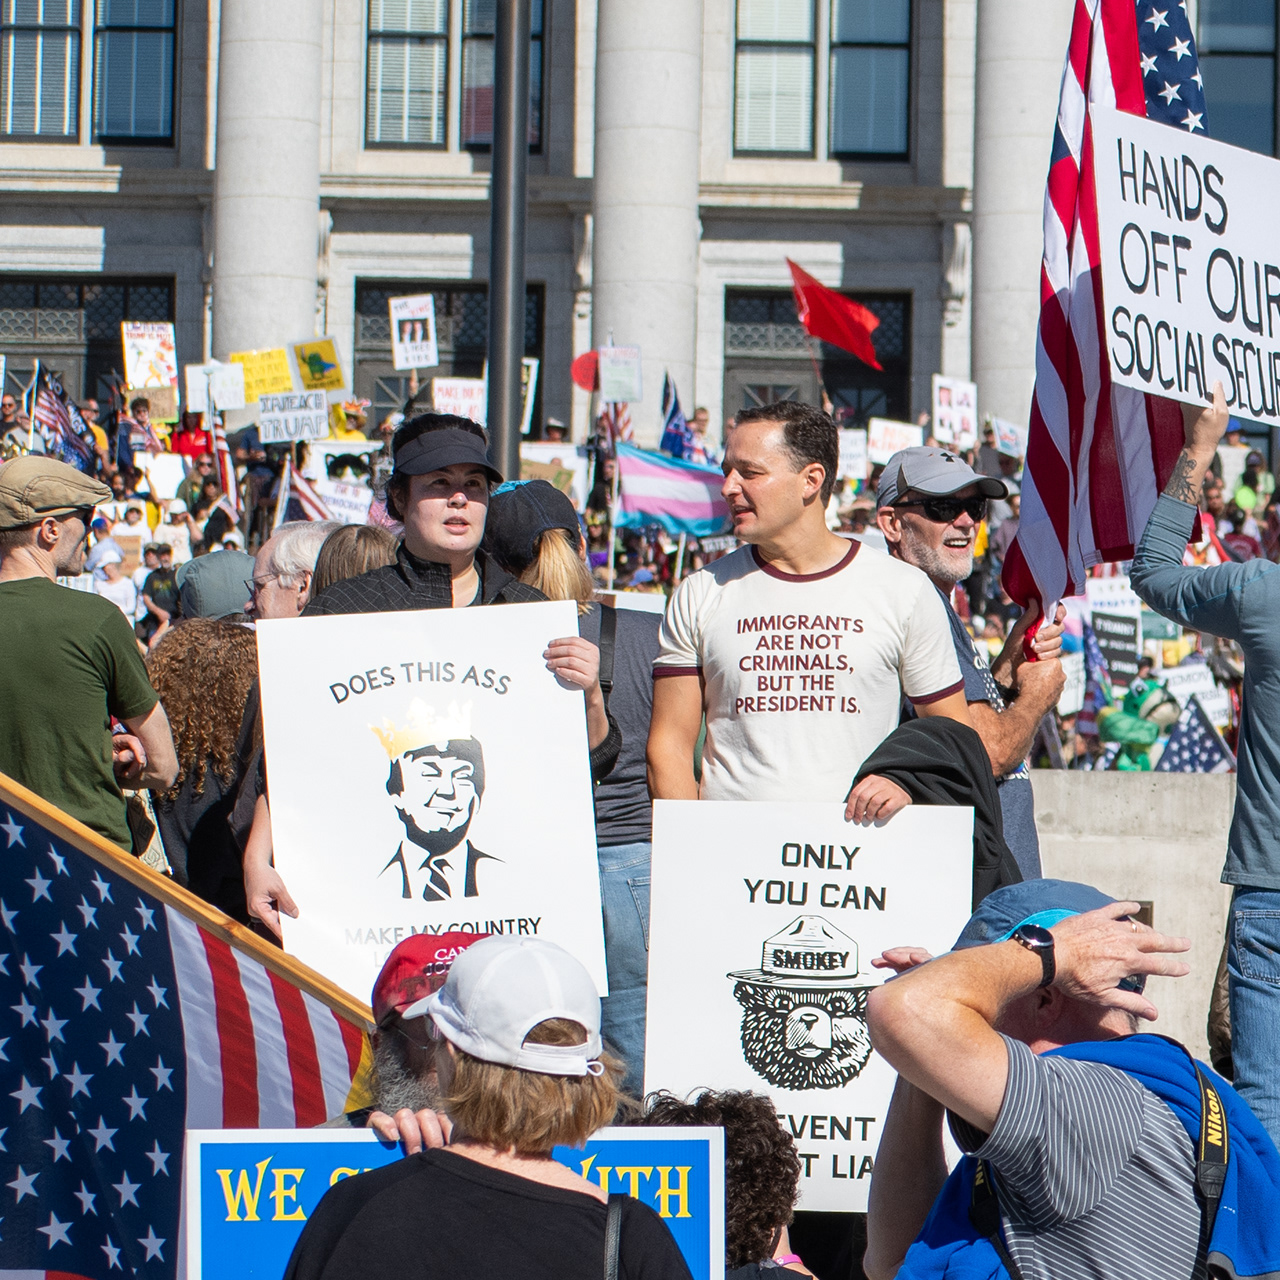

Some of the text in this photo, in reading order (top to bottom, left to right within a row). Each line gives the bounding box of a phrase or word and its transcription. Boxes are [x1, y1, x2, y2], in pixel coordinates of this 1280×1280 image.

[1117, 137, 1228, 235] HANDS
[1119, 221, 1191, 303] OFF
[1112, 305, 1215, 396] SOCIAL
[261, 414, 327, 439] TRUMP
[737, 614, 865, 634] IMMIGRANTS
[755, 633, 843, 651] ARE NOT
[738, 653, 855, 675] CRIMINALS,
[329, 661, 512, 704] DOES THIS ASS
[757, 674, 835, 692] BUT THE
[735, 696, 861, 714] PRESIDENT IS.
[780, 843, 861, 872] ONLY
[743, 878, 888, 911] YOU CAN
[345, 926, 404, 945] MAKE
[773, 949, 850, 971] SMOKEY
[1206, 1088, 1223, 1147] Nikon
[216, 1153, 693, 1222] WE ITH
